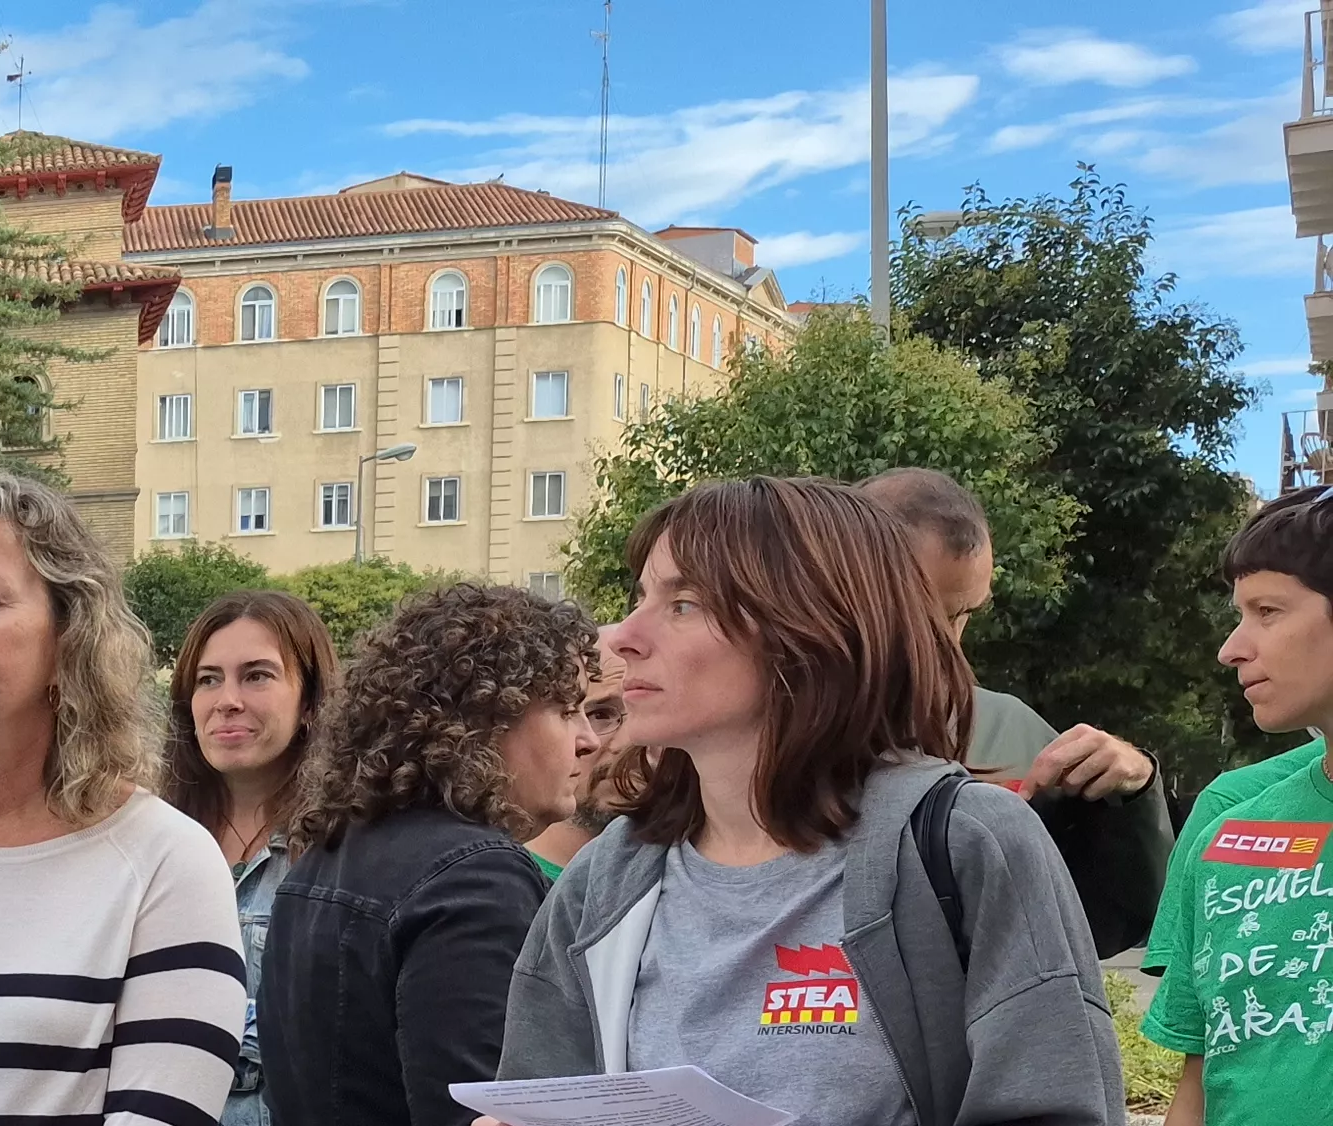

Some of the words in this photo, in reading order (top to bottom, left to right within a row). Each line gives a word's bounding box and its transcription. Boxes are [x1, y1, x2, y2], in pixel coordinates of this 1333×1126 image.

[1216, 833, 1290, 852] CCOO
[1204, 863, 1333, 920] ESCUEL
[1219, 944, 1279, 982] DE
[767, 985, 855, 1010] STEA
[757, 1024, 857, 1036] INTERSINDICAL
[1205, 1002, 1309, 1046] ARA
